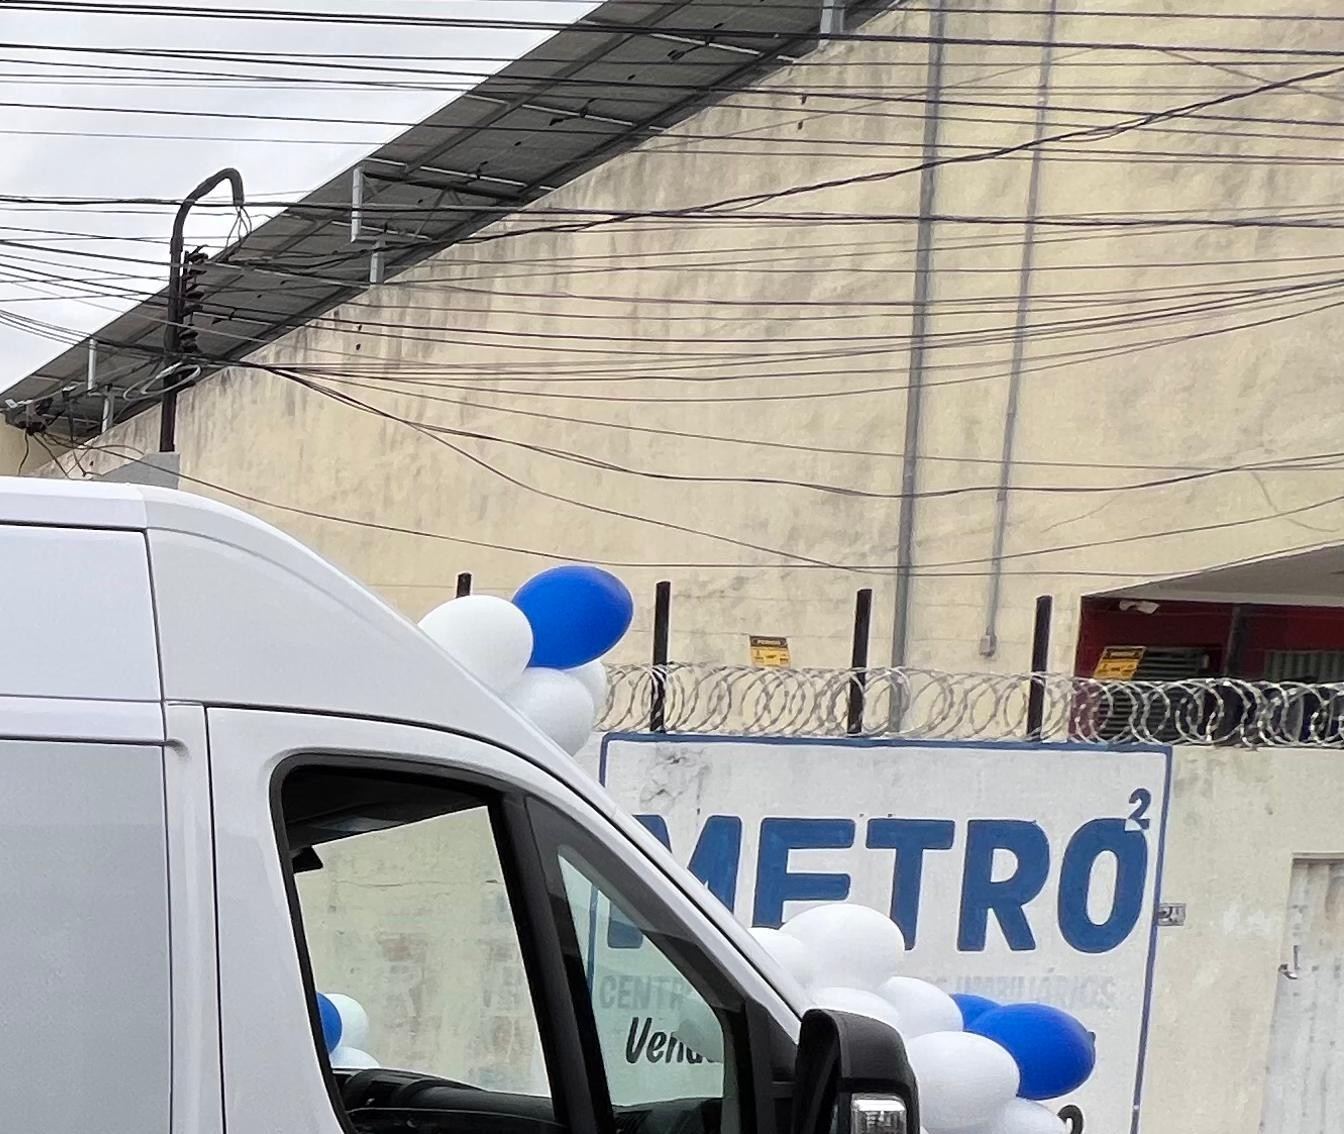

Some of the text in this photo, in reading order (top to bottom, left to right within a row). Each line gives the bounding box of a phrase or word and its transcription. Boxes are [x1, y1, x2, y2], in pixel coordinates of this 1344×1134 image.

[1125, 788, 1151, 831] 2
[608, 814, 1148, 954] METRO
[599, 975, 694, 1009] CENTR
